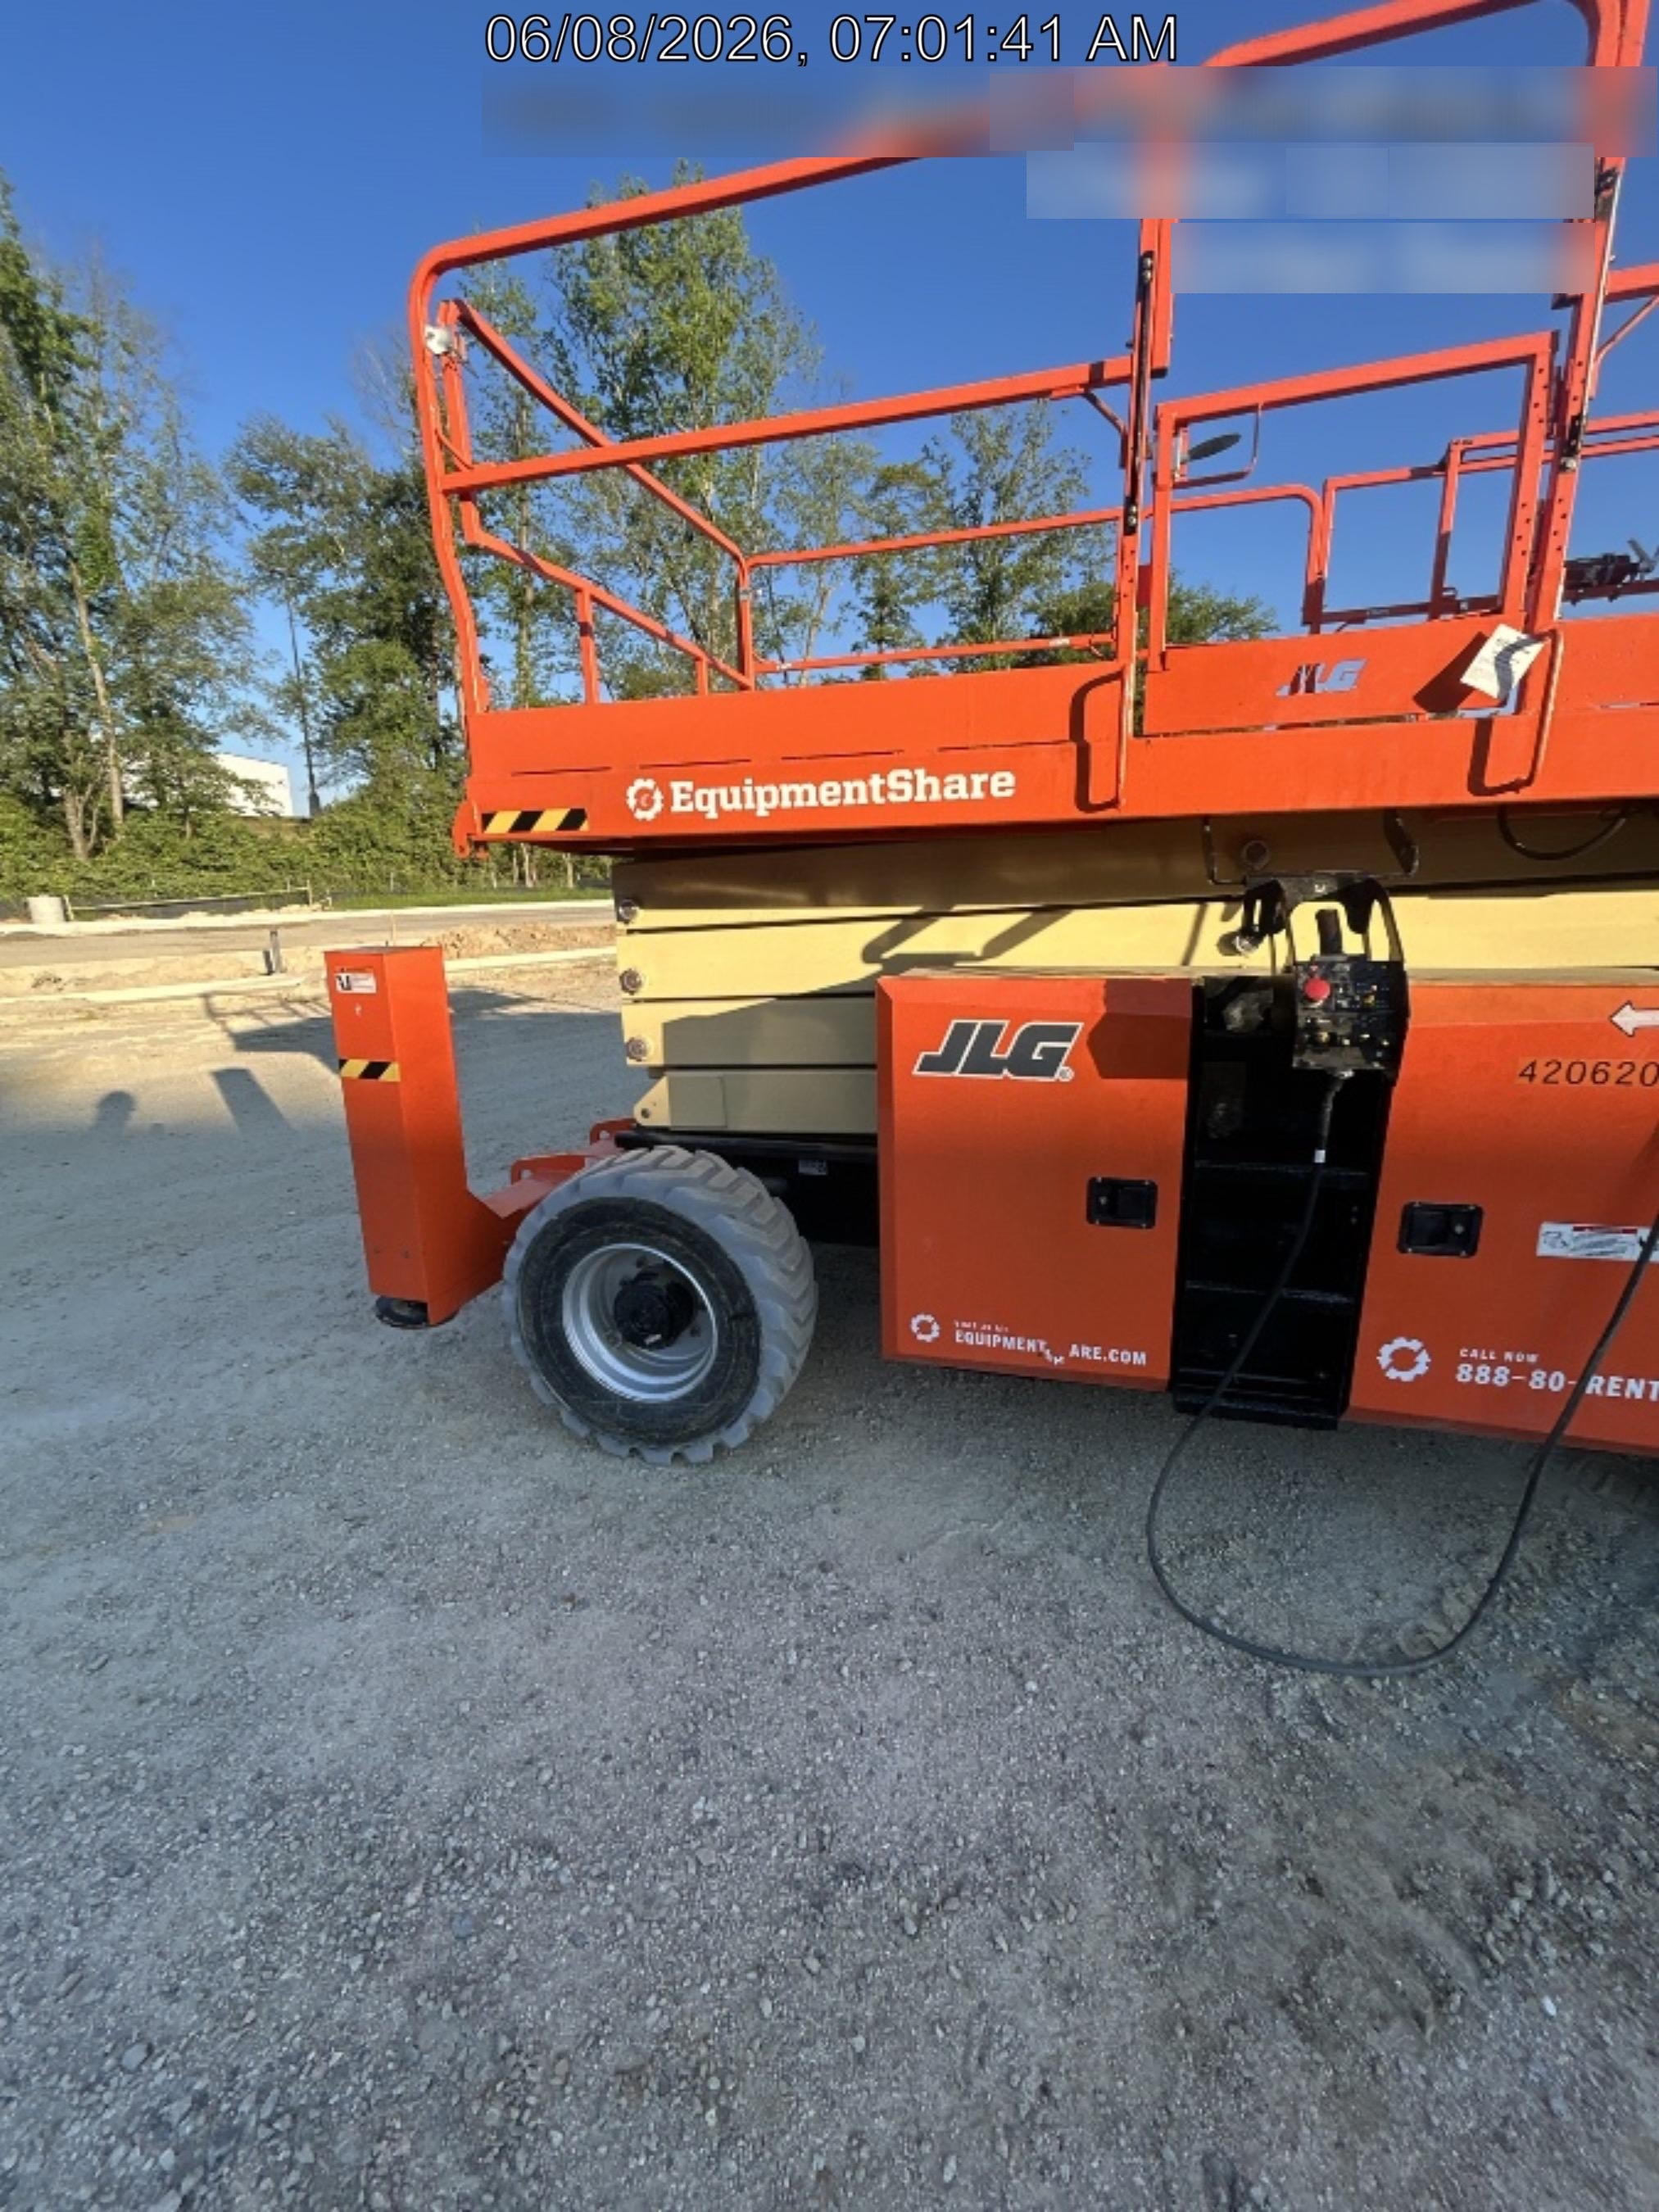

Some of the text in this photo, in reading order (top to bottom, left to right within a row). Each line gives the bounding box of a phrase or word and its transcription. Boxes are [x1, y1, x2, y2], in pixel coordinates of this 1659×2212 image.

[1276, 658, 1367, 698] JLG
[670, 768, 1016, 818] EquipmentShare
[1518, 1058, 1659, 1087] 420620
[1459, 1348, 1540, 1363] CALL NOW
